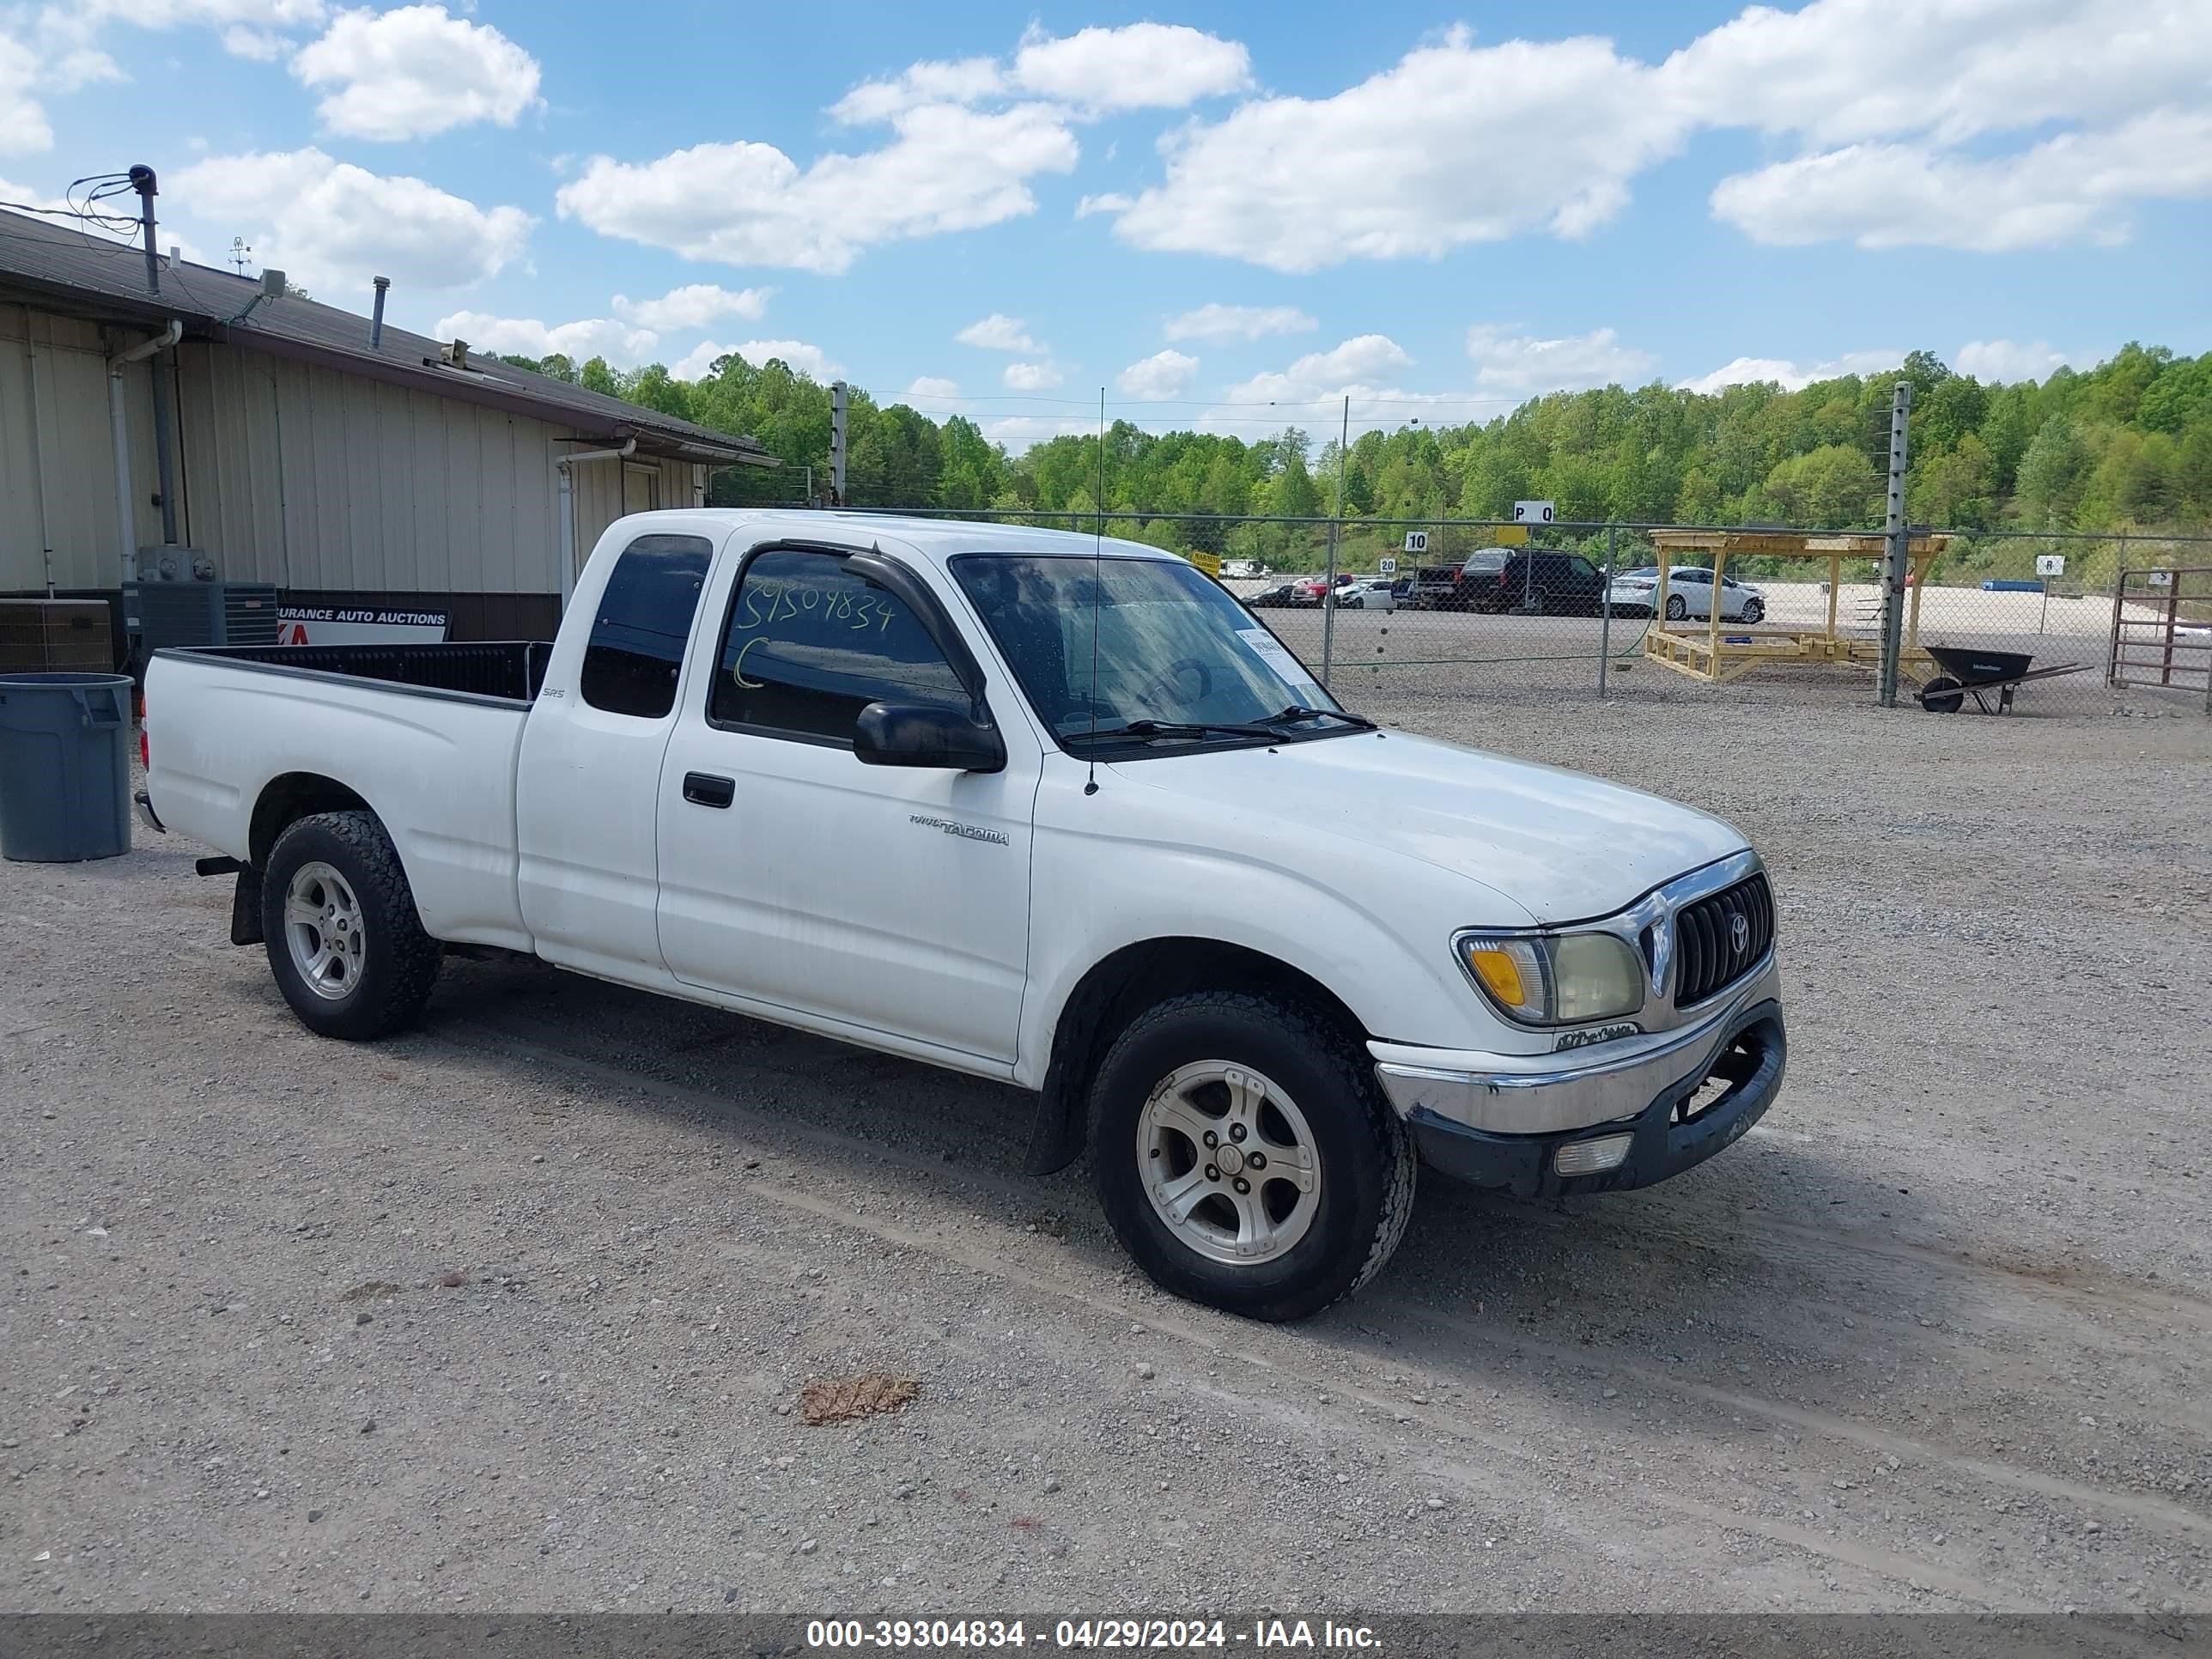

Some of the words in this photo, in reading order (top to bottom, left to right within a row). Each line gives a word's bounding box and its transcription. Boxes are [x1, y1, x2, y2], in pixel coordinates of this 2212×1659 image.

[1516, 507, 1525, 520] P
[1542, 507, 1553, 522] Q
[1409, 534, 1425, 549] 10
[1382, 561, 1394, 571] 20
[2046, 560, 2053, 570] R
[1821, 584, 1831, 594] 10
[276, 607, 334, 621] URANCE
[337, 610, 374, 623] AUTO
[376, 611, 447, 625] AUCTIONS
[733, 636, 771, 689] C
[941, 822, 1010, 846] TACOMA
